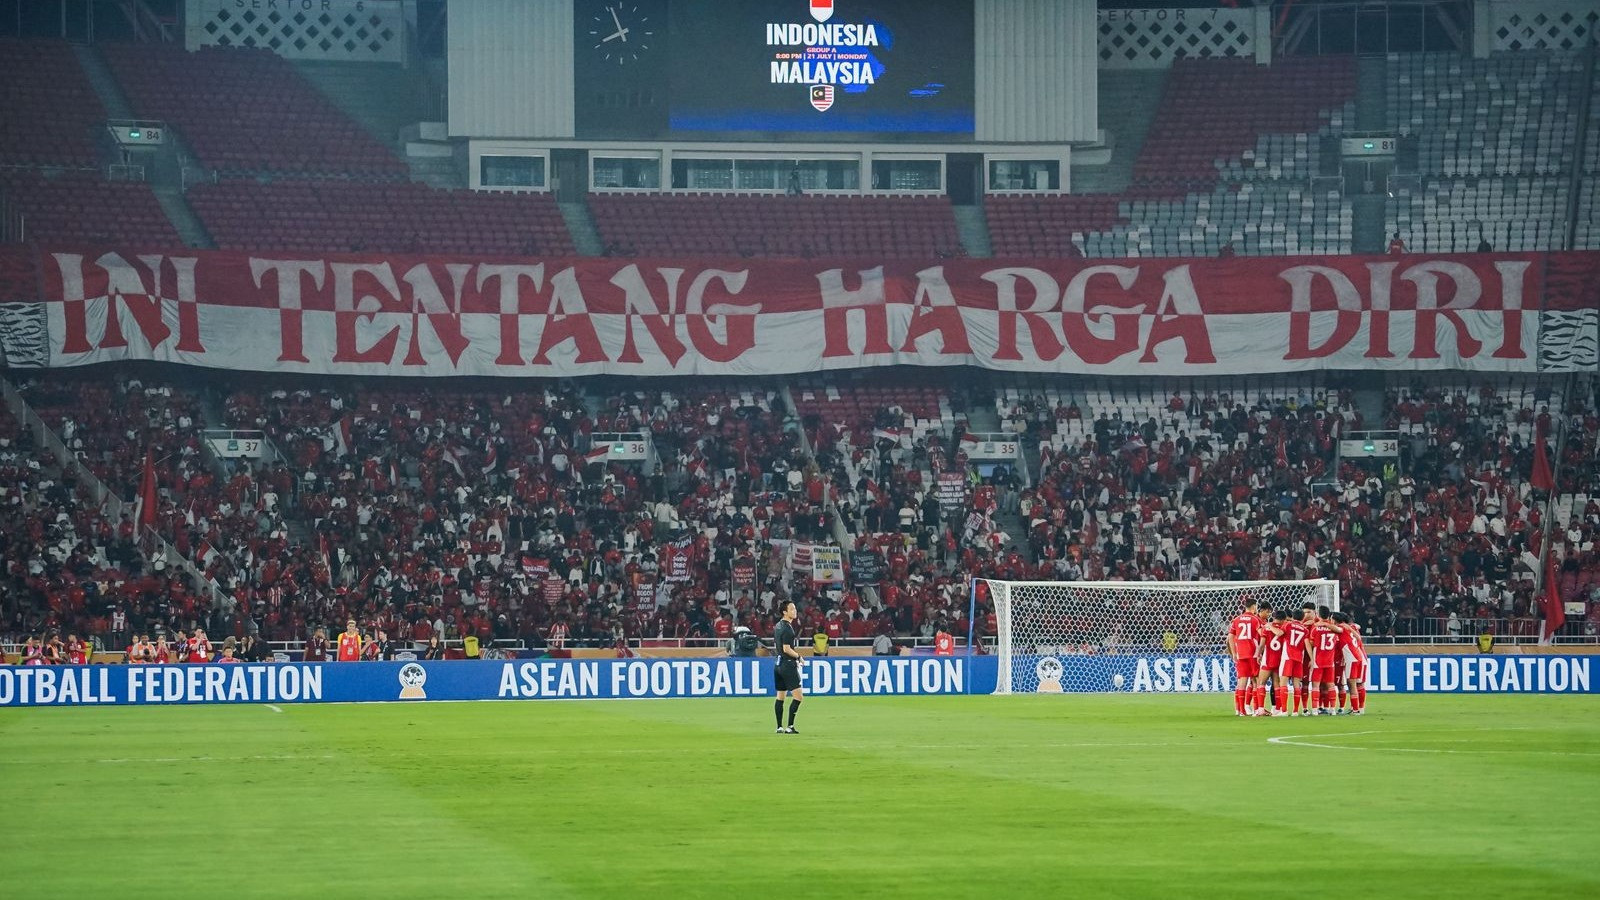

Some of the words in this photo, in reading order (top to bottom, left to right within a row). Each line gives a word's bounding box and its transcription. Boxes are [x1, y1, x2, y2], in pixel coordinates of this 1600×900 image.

[235, 0, 331, 10] SEKTOR
[356, 1, 364, 12] 6
[1210, 9, 1218, 20] 7
[766, 23, 878, 46] INDONESIA
[770, 61, 875, 84] MALAYSIA
[146, 130, 160, 140] 84
[1382, 141, 1394, 150] 81
[50, 251, 206, 357] INI
[248, 257, 762, 369] TENTANG
[815, 264, 1217, 365] HARGA
[1278, 260, 1532, 360] DIRI
[245, 442, 258, 451] 37
[632, 444, 645, 453] 36
[1002, 444, 1015, 454] 35
[1382, 442, 1396, 452] 34
[1238, 622, 1252, 640] 21
[1289, 629, 1305, 647] 17
[1270, 635, 1281, 651] 6
[1320, 633, 1335, 651] 13
[499, 662, 598, 696] ASEAN
[611, 660, 767, 696] FOOTBALL
[800, 659, 963, 694] EDERATION
[1133, 658, 1230, 692] ASEAN
[1406, 657, 1590, 691] FEDERATION
[128, 666, 322, 702] FEDERATION
